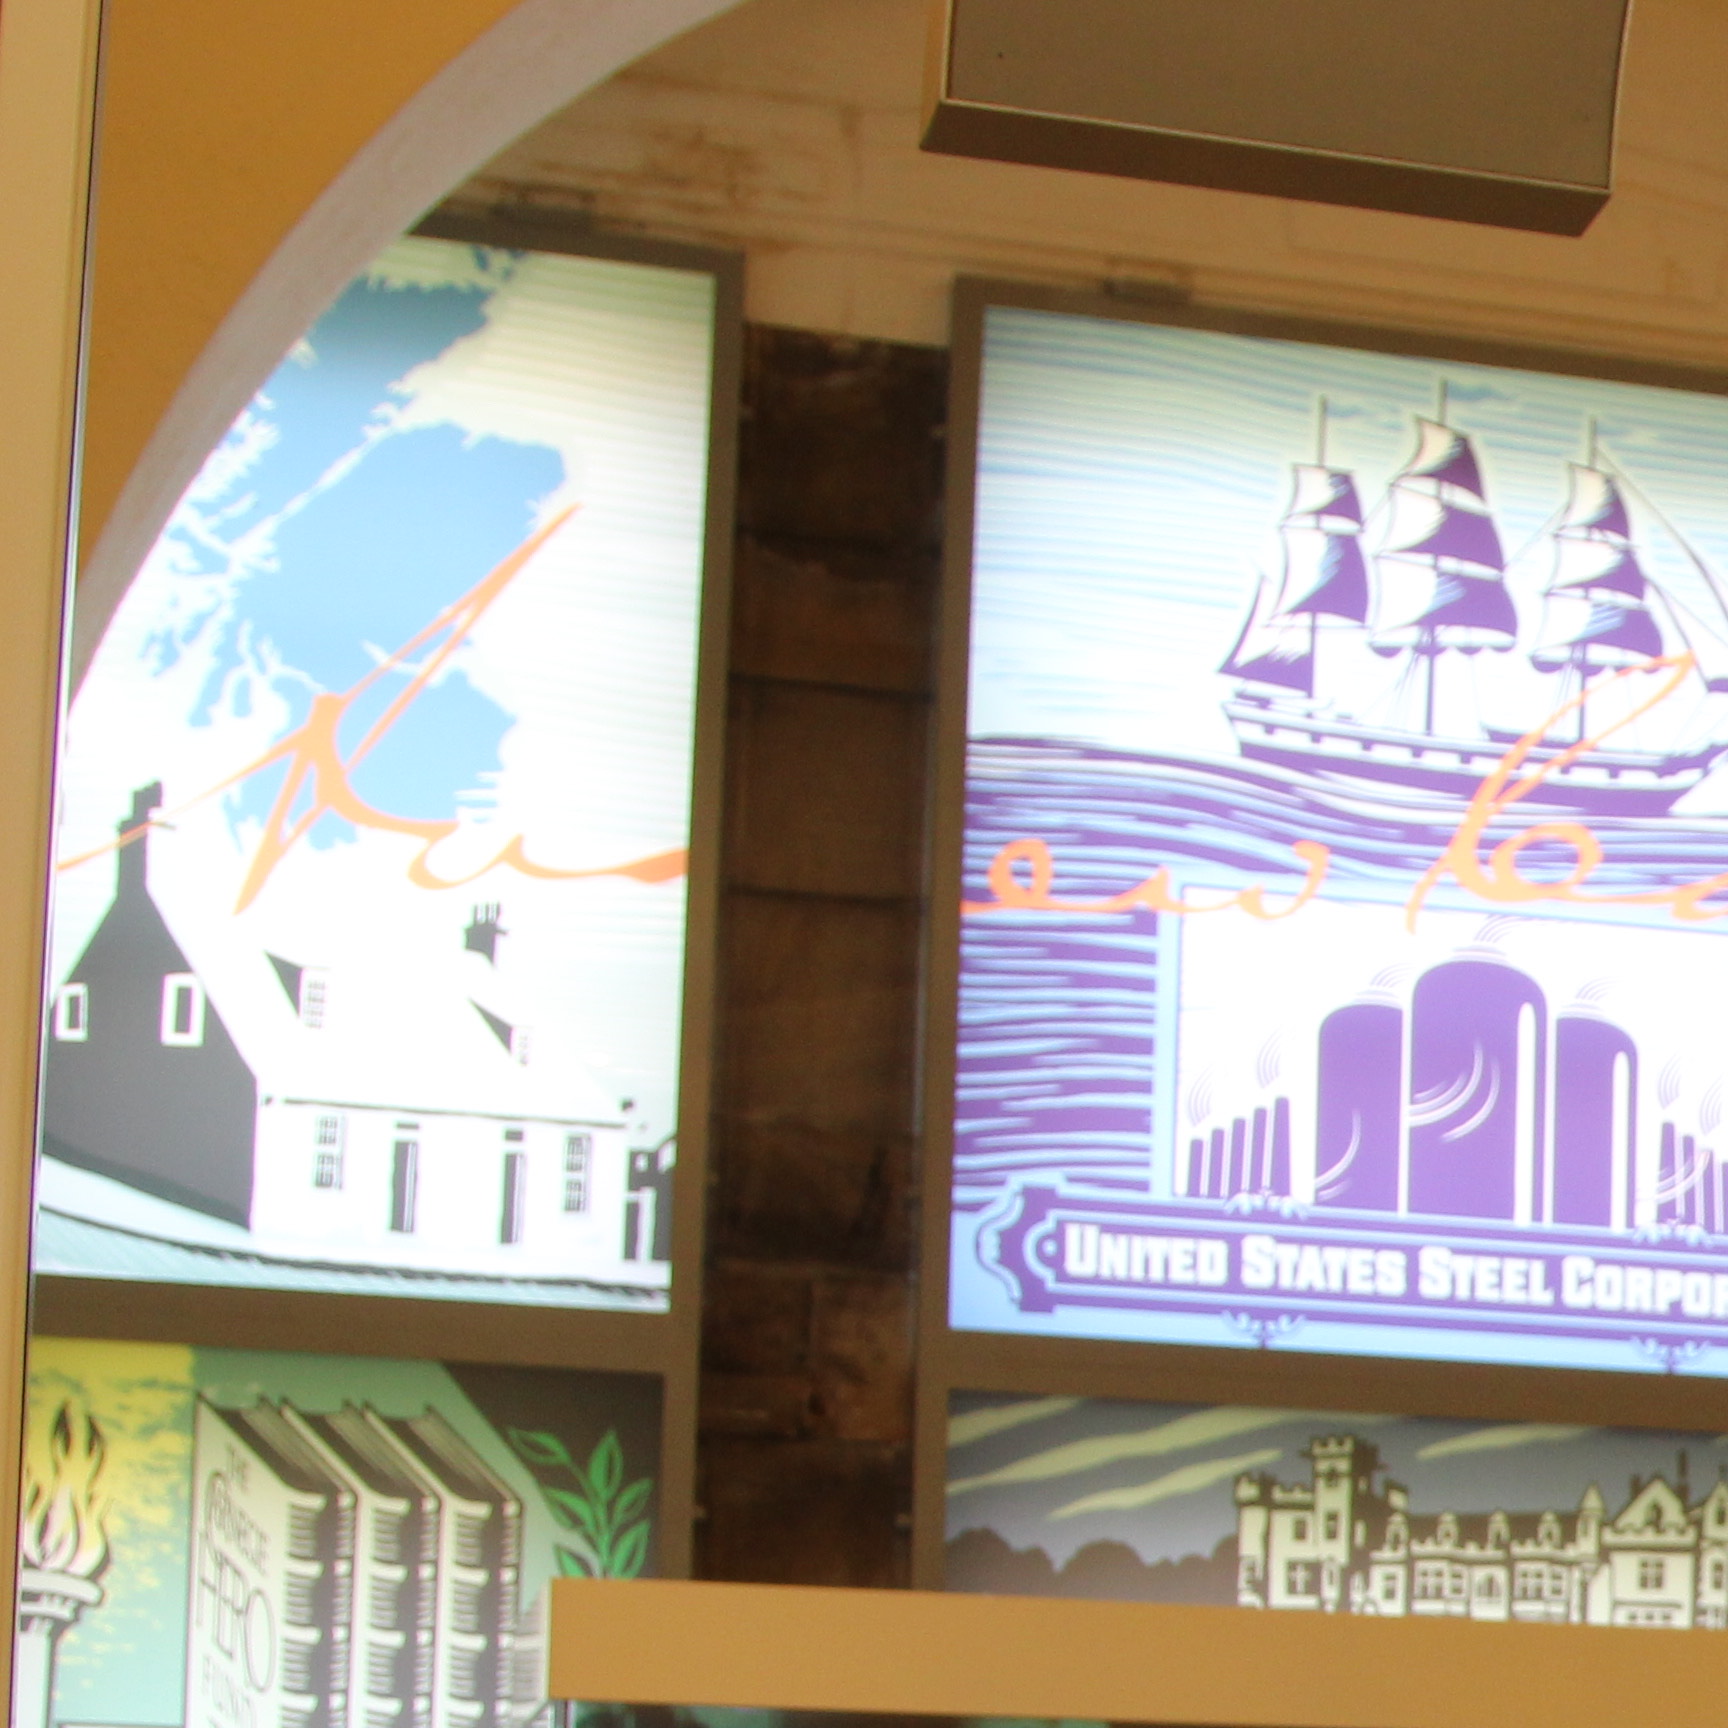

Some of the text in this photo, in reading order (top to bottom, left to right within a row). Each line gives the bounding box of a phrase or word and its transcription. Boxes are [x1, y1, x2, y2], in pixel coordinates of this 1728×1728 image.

[1064, 1223, 1229, 1287] UNITED
[1239, 1235, 1405, 1297] STATES
[1417, 1245, 1554, 1308] STEEL
